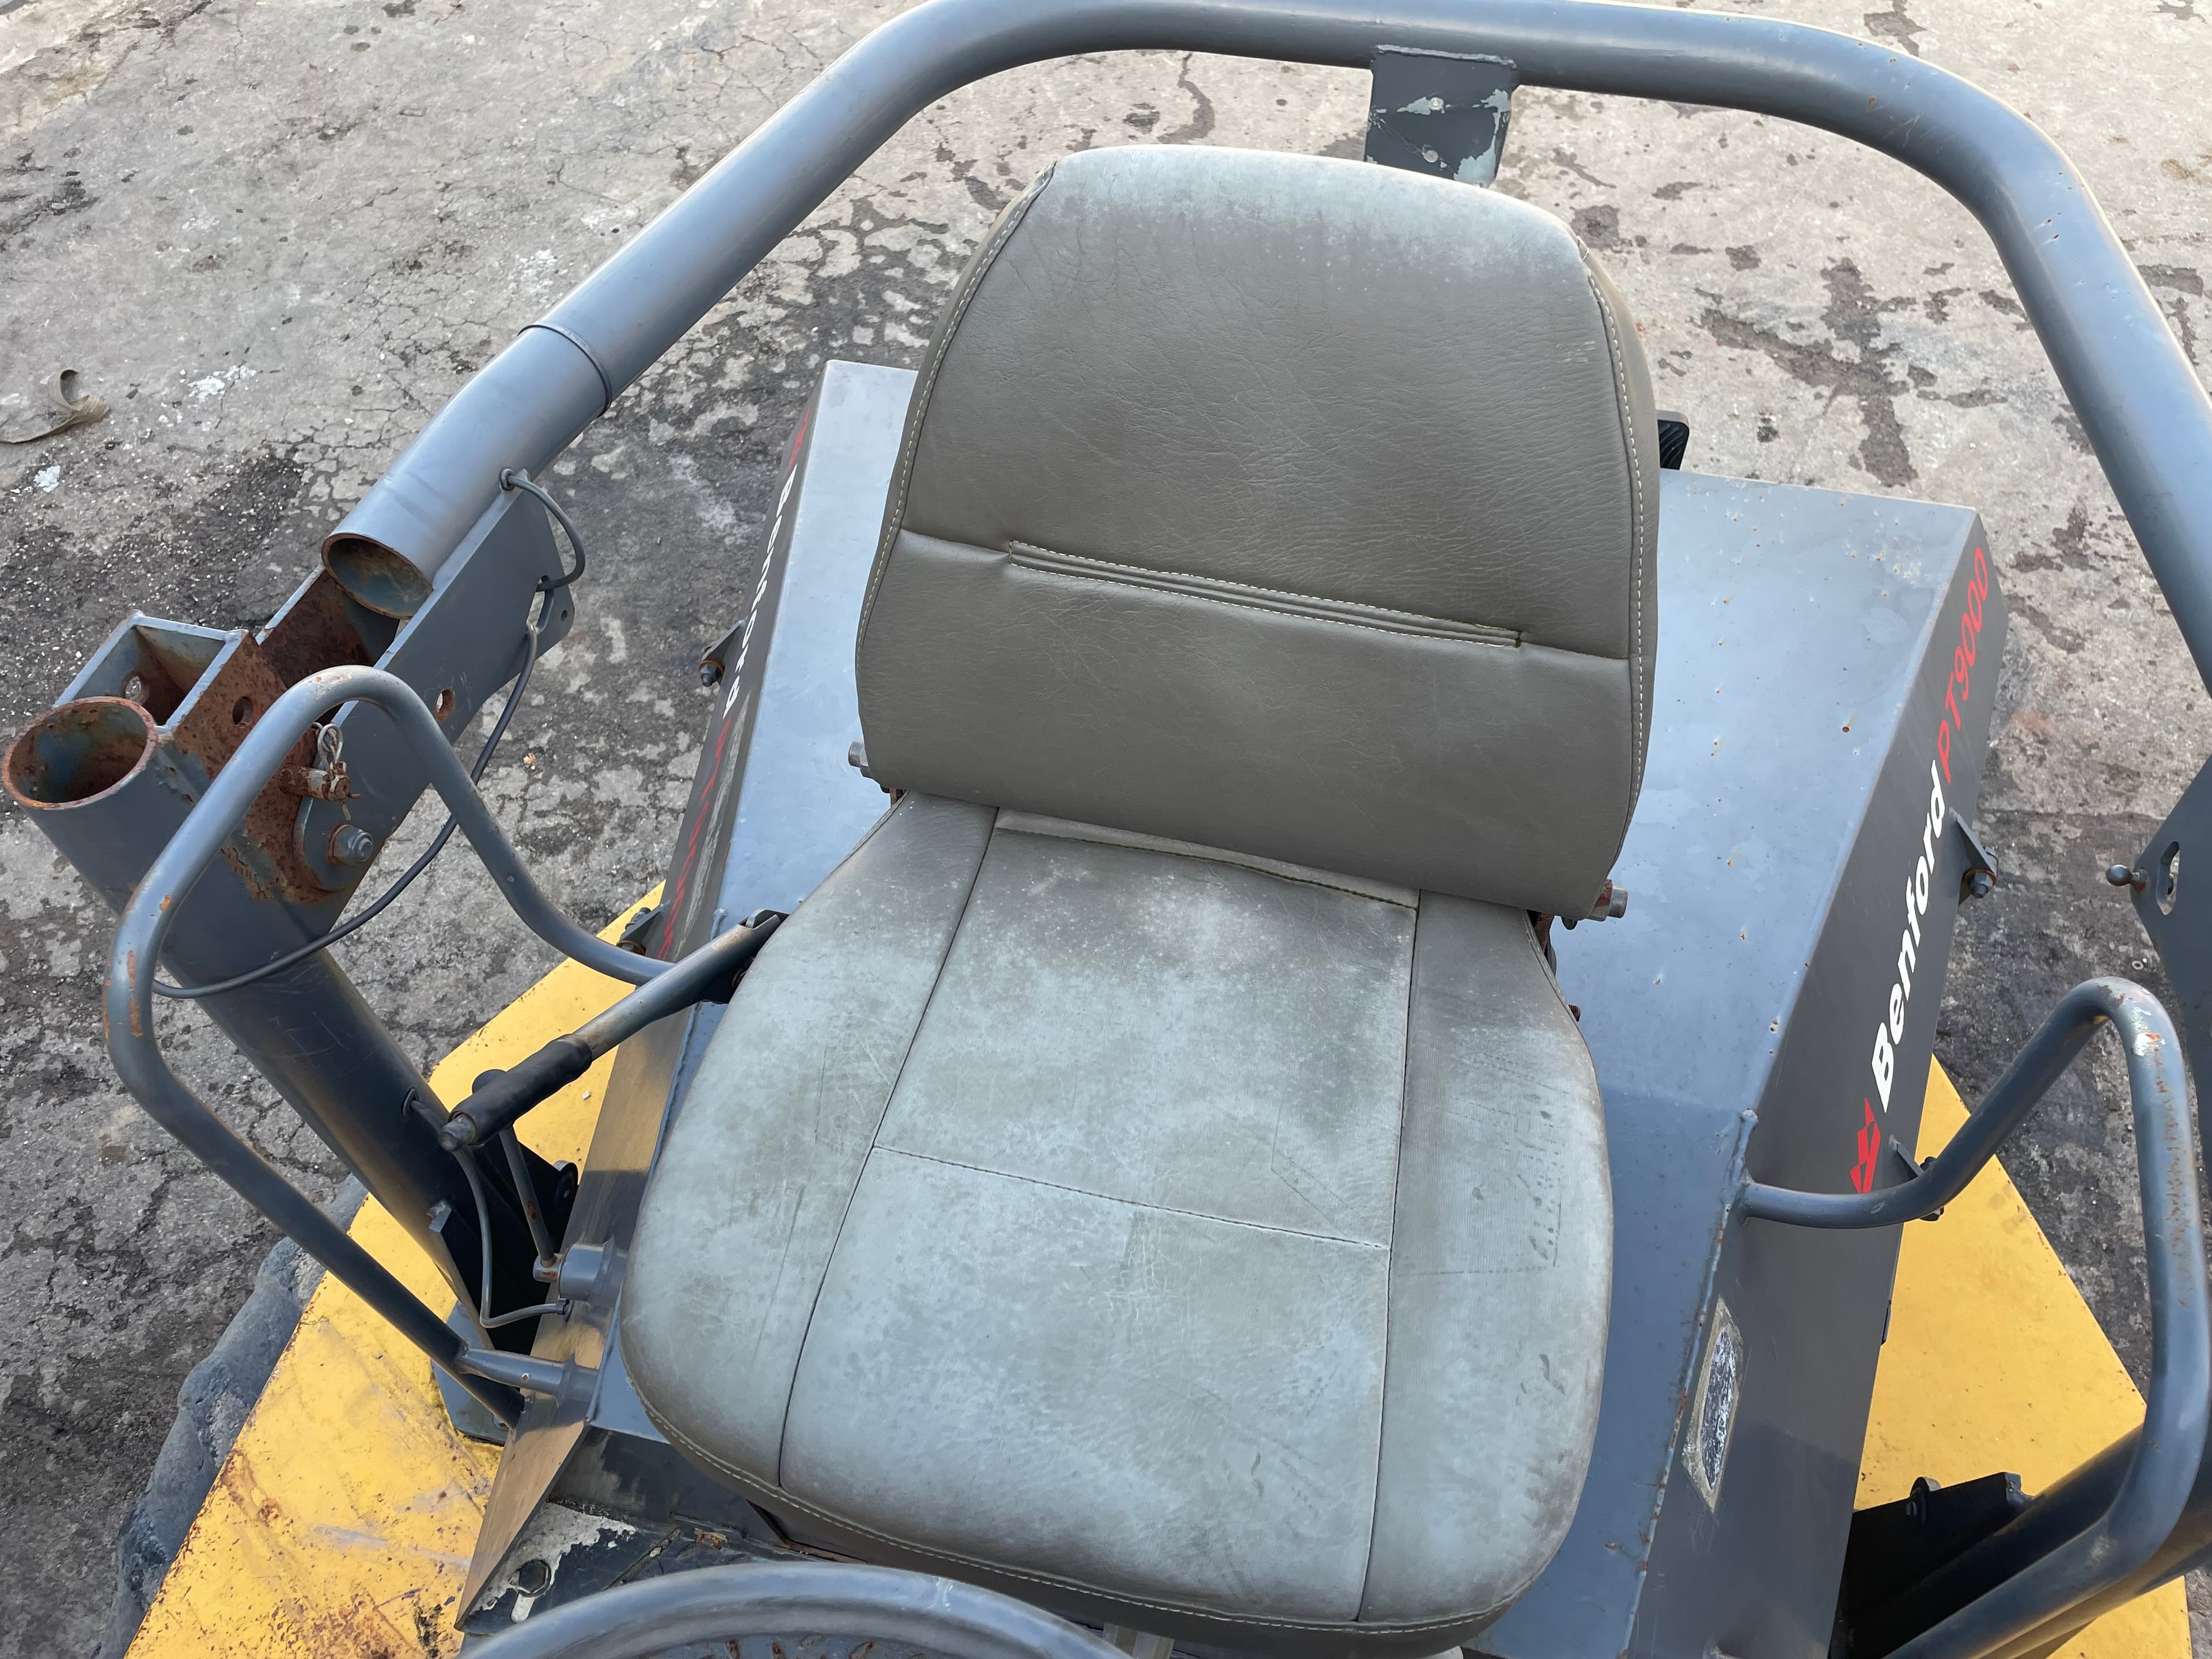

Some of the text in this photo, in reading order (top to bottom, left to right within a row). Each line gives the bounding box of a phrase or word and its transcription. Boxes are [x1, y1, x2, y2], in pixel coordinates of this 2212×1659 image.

[722, 463, 798, 720] Benford
[1871, 546, 1989, 1113] Benford PT9000
